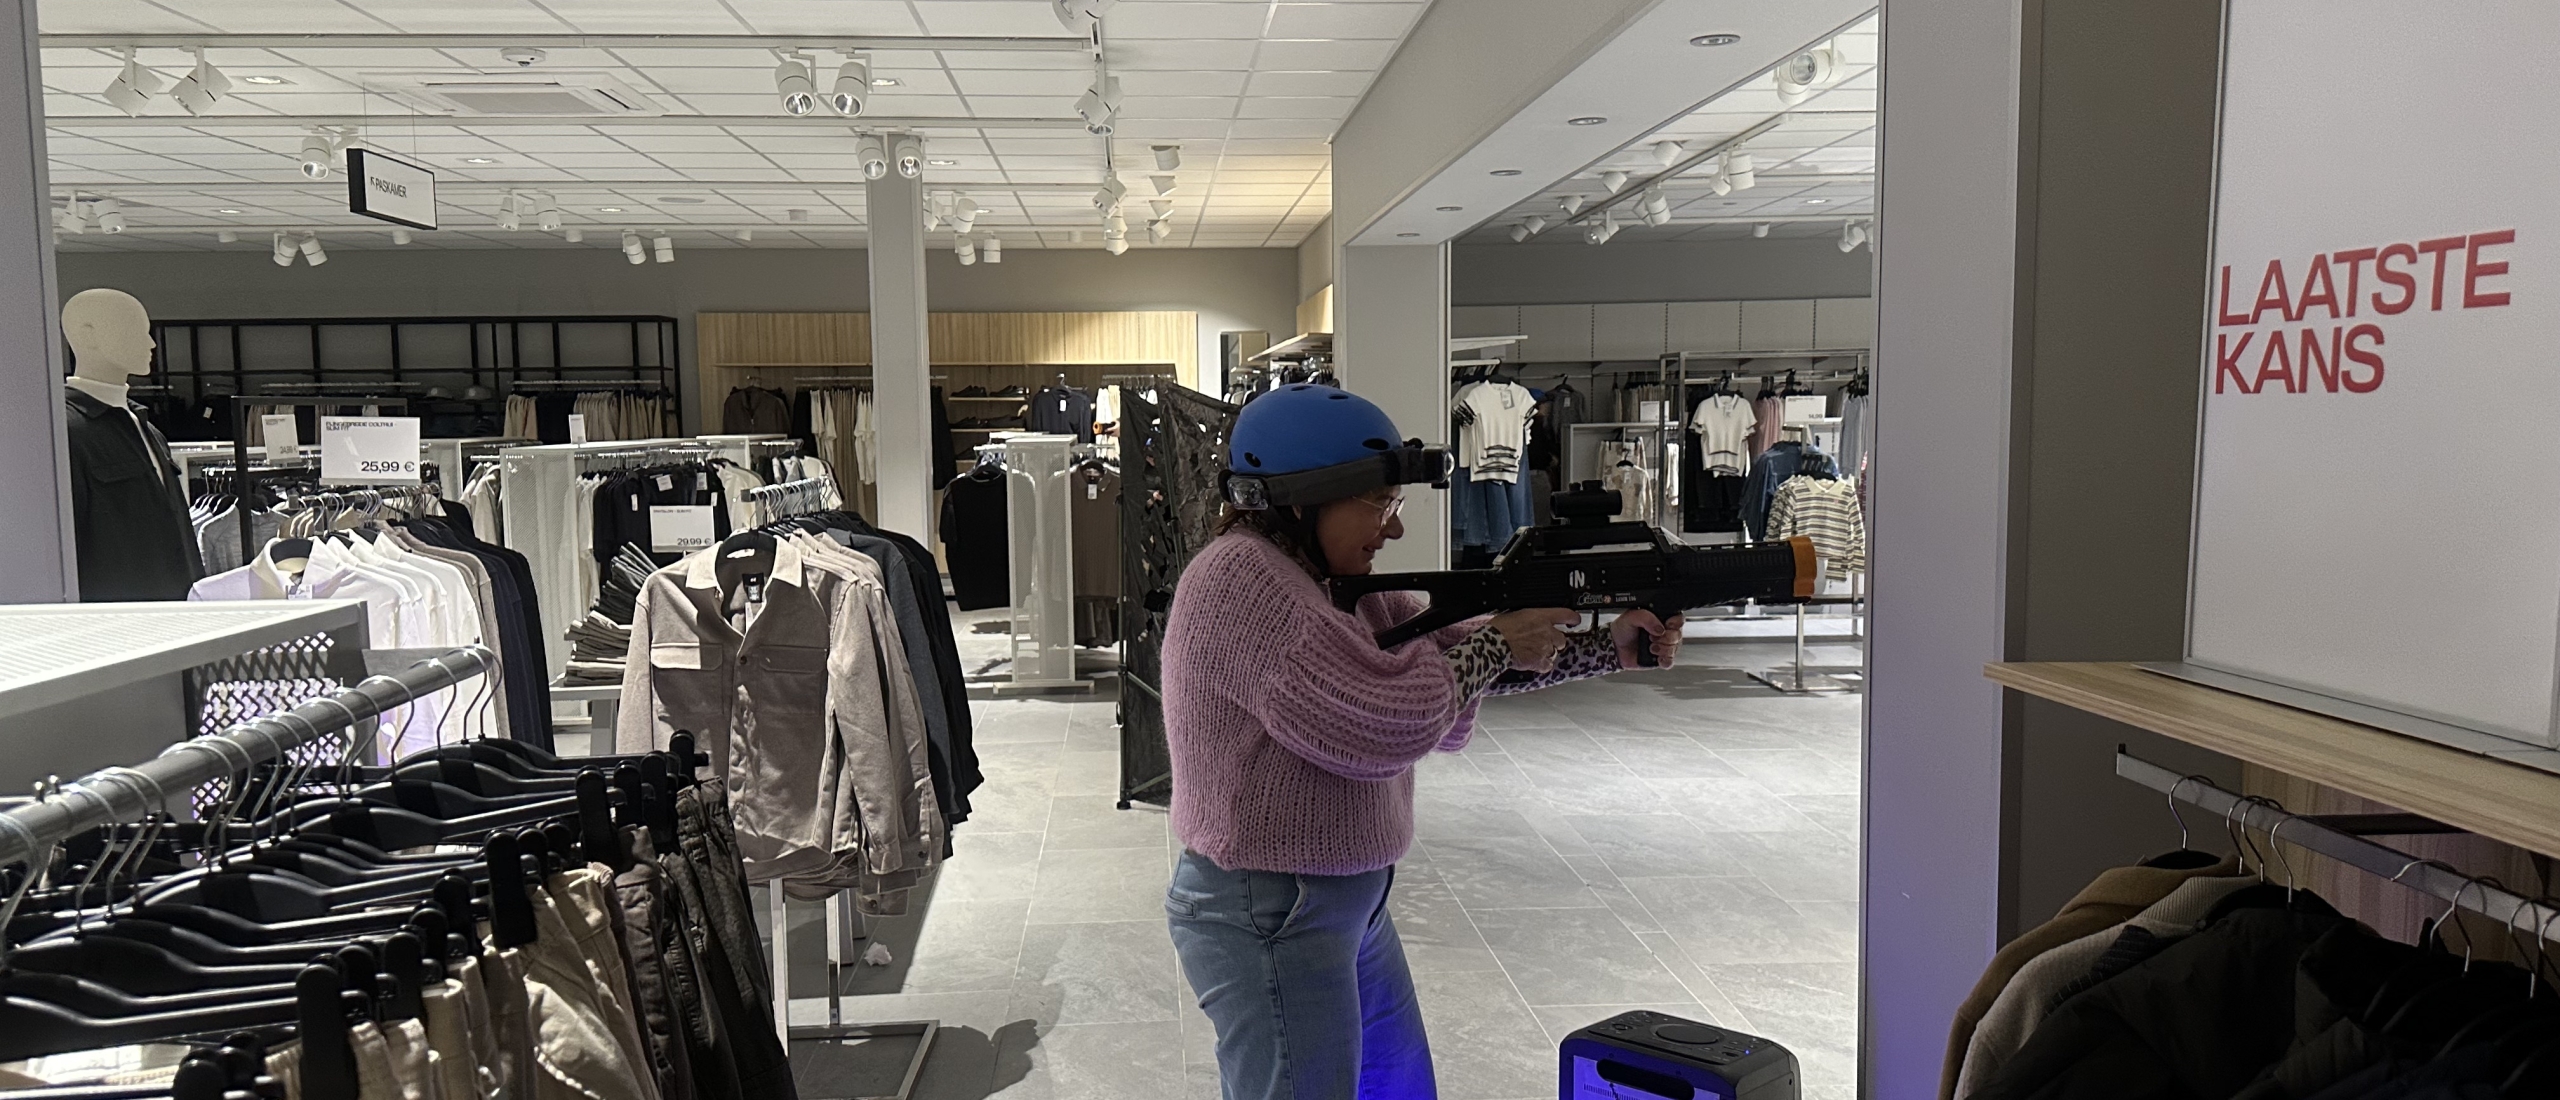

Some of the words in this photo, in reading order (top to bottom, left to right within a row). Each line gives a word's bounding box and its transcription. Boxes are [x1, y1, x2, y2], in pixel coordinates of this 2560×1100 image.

[375, 177, 407, 198] PASKAMER
[2218, 228, 2515, 327] LAATSTE
[2215, 323, 2385, 394] KANS
[361, 461, 399, 473] 25,99
[404, 461, 415, 472] €
